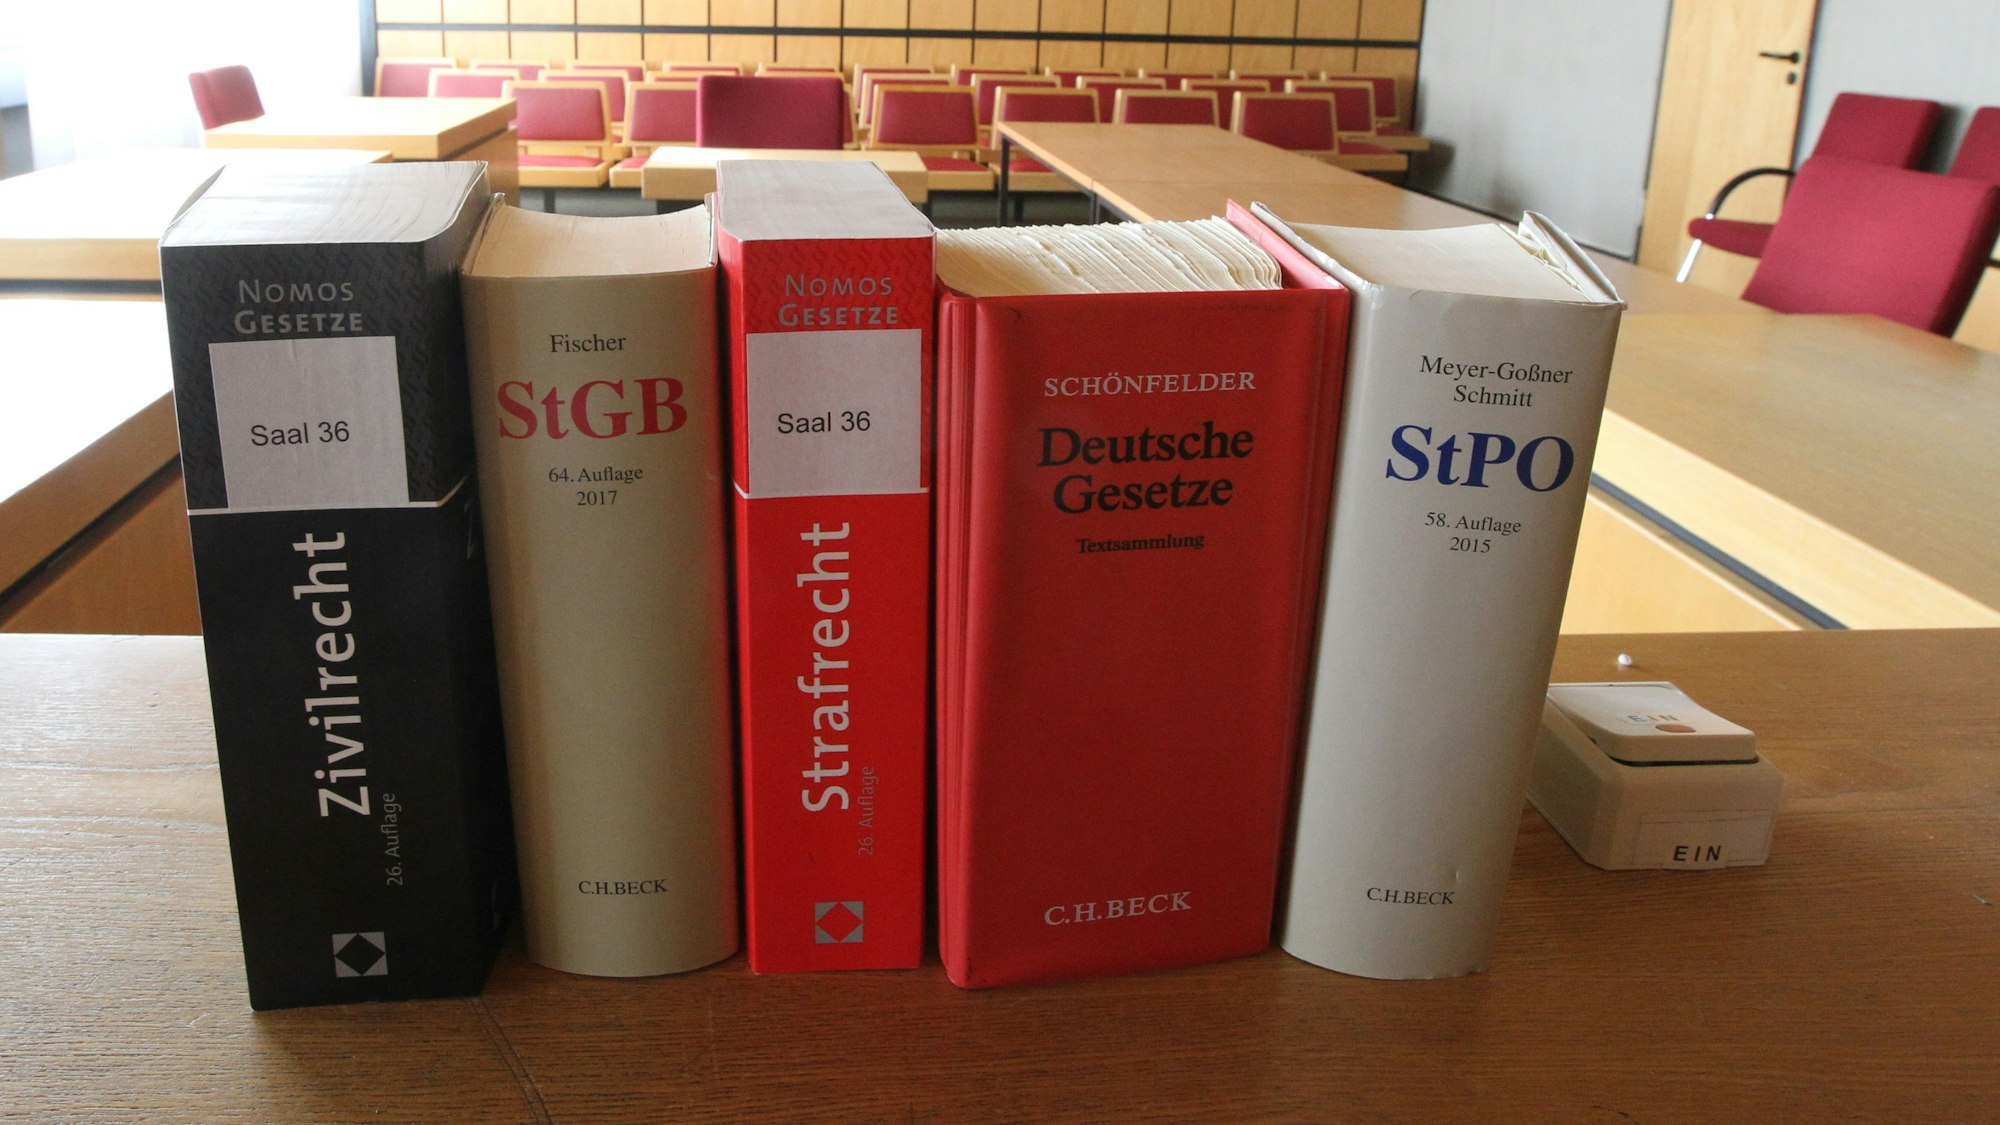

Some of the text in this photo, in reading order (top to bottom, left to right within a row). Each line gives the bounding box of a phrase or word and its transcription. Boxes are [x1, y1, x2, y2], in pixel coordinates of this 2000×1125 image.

[549, 333, 627, 353] Fischer
[1418, 354, 1574, 384] Meyer-Goßner
[1044, 370, 1256, 398] SCHÖNFELDER
[497, 377, 689, 440] StGB
[1452, 386, 1534, 408] Schmitt
[250, 420, 351, 447] Saal 36
[777, 410, 871, 434] Saal 36
[1037, 420, 1254, 468] Deutsche
[1384, 424, 1574, 492] StPO
[548, 464, 644, 484] 64. Auflage
[576, 489, 617, 507] 2017
[1052, 472, 1234, 514] Gesetze
[1424, 511, 1522, 535] 58. Auflage
[1076, 532, 1206, 554] Textsammlung
[1449, 536, 1492, 555] 2015
[292, 532, 370, 818] Zivilrecht
[797, 522, 851, 812] Strafrecht
[1627, 714, 1679, 723] EIN
[857, 766, 877, 856] 26. Auflage
[380, 792, 403, 886] 26. Auflage
[1673, 845, 1722, 862] EIN
[578, 879, 669, 896] C.H.BECK
[1366, 886, 1456, 906] C.H.BECK
[1043, 891, 1192, 926] C.H.BECK
